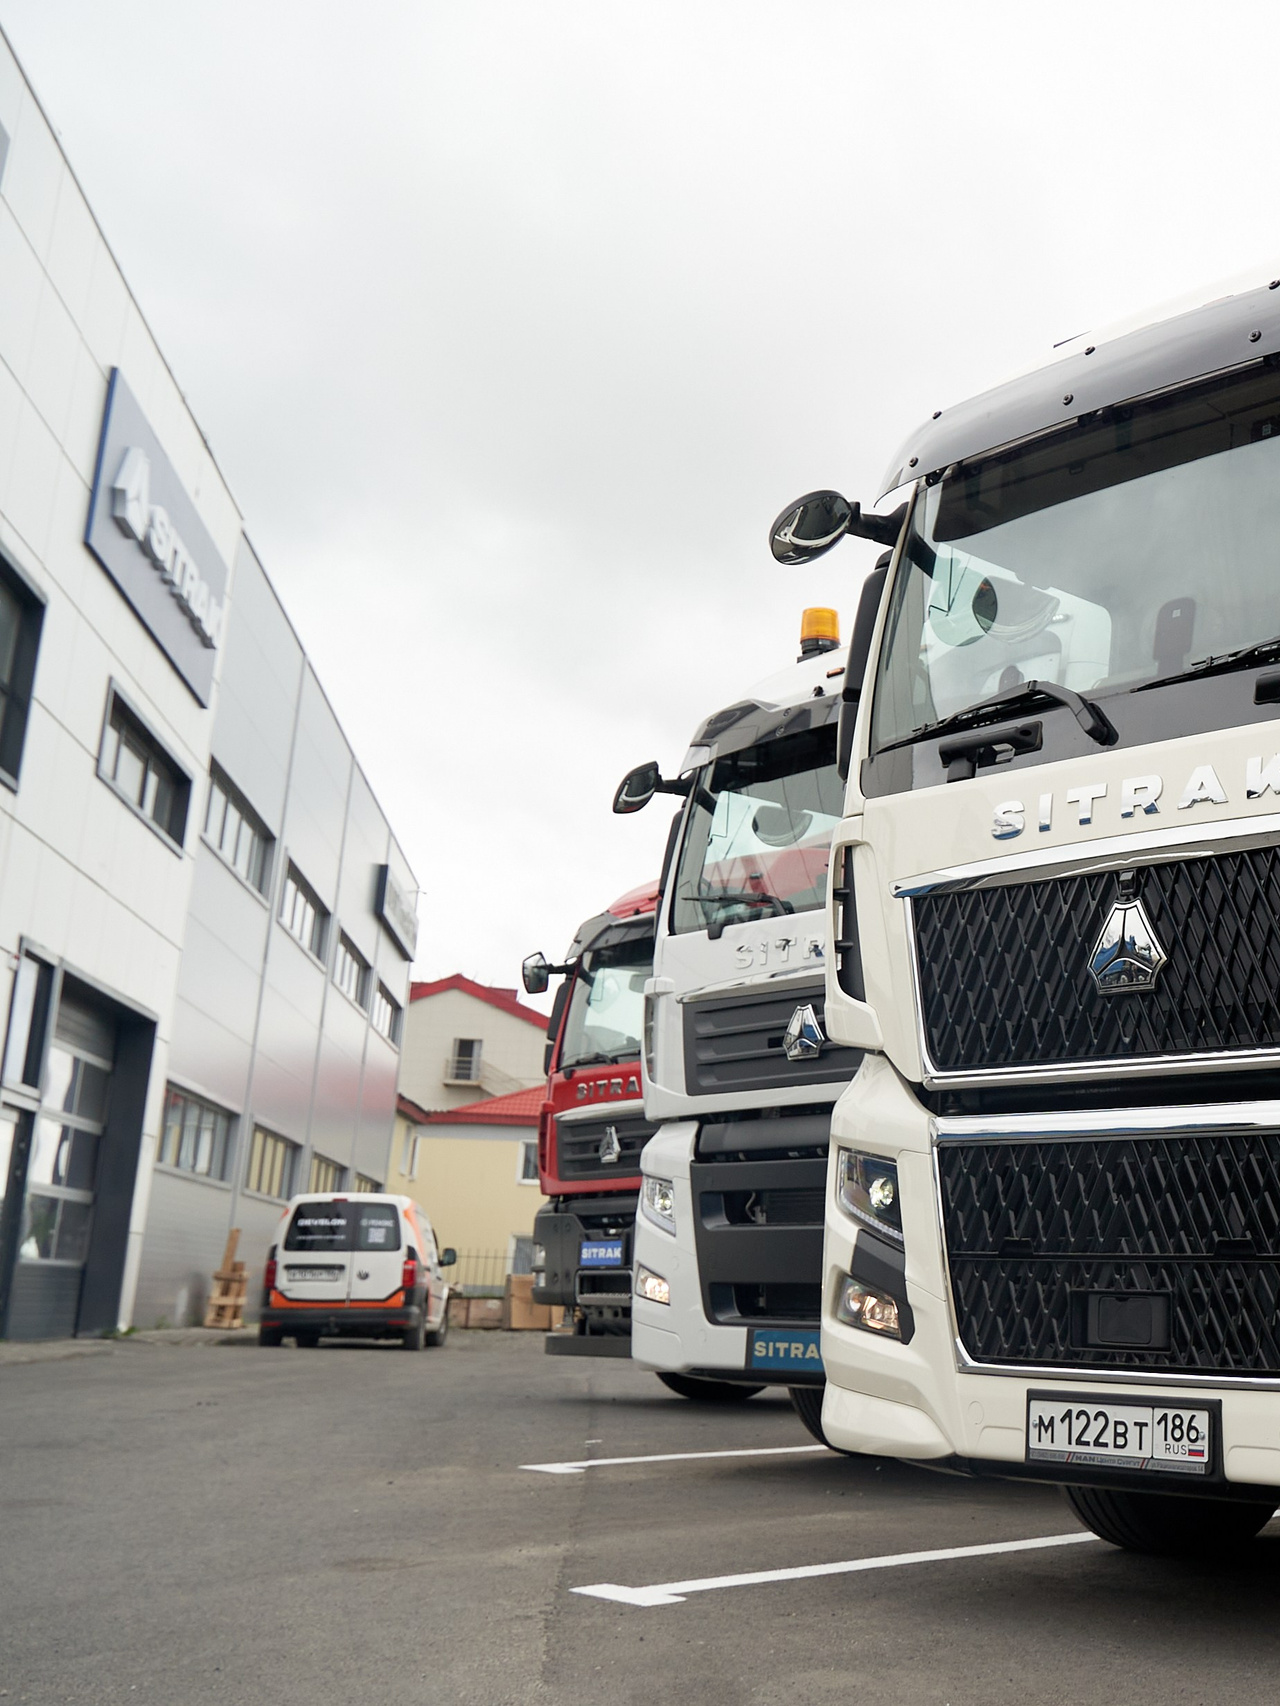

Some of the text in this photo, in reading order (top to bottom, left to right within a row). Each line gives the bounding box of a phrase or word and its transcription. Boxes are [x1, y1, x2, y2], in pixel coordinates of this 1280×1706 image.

[581, 1247, 622, 1259] SITRAK
[1156, 1413, 1200, 1443] 186
[1165, 1443, 1187, 1456] RUS
